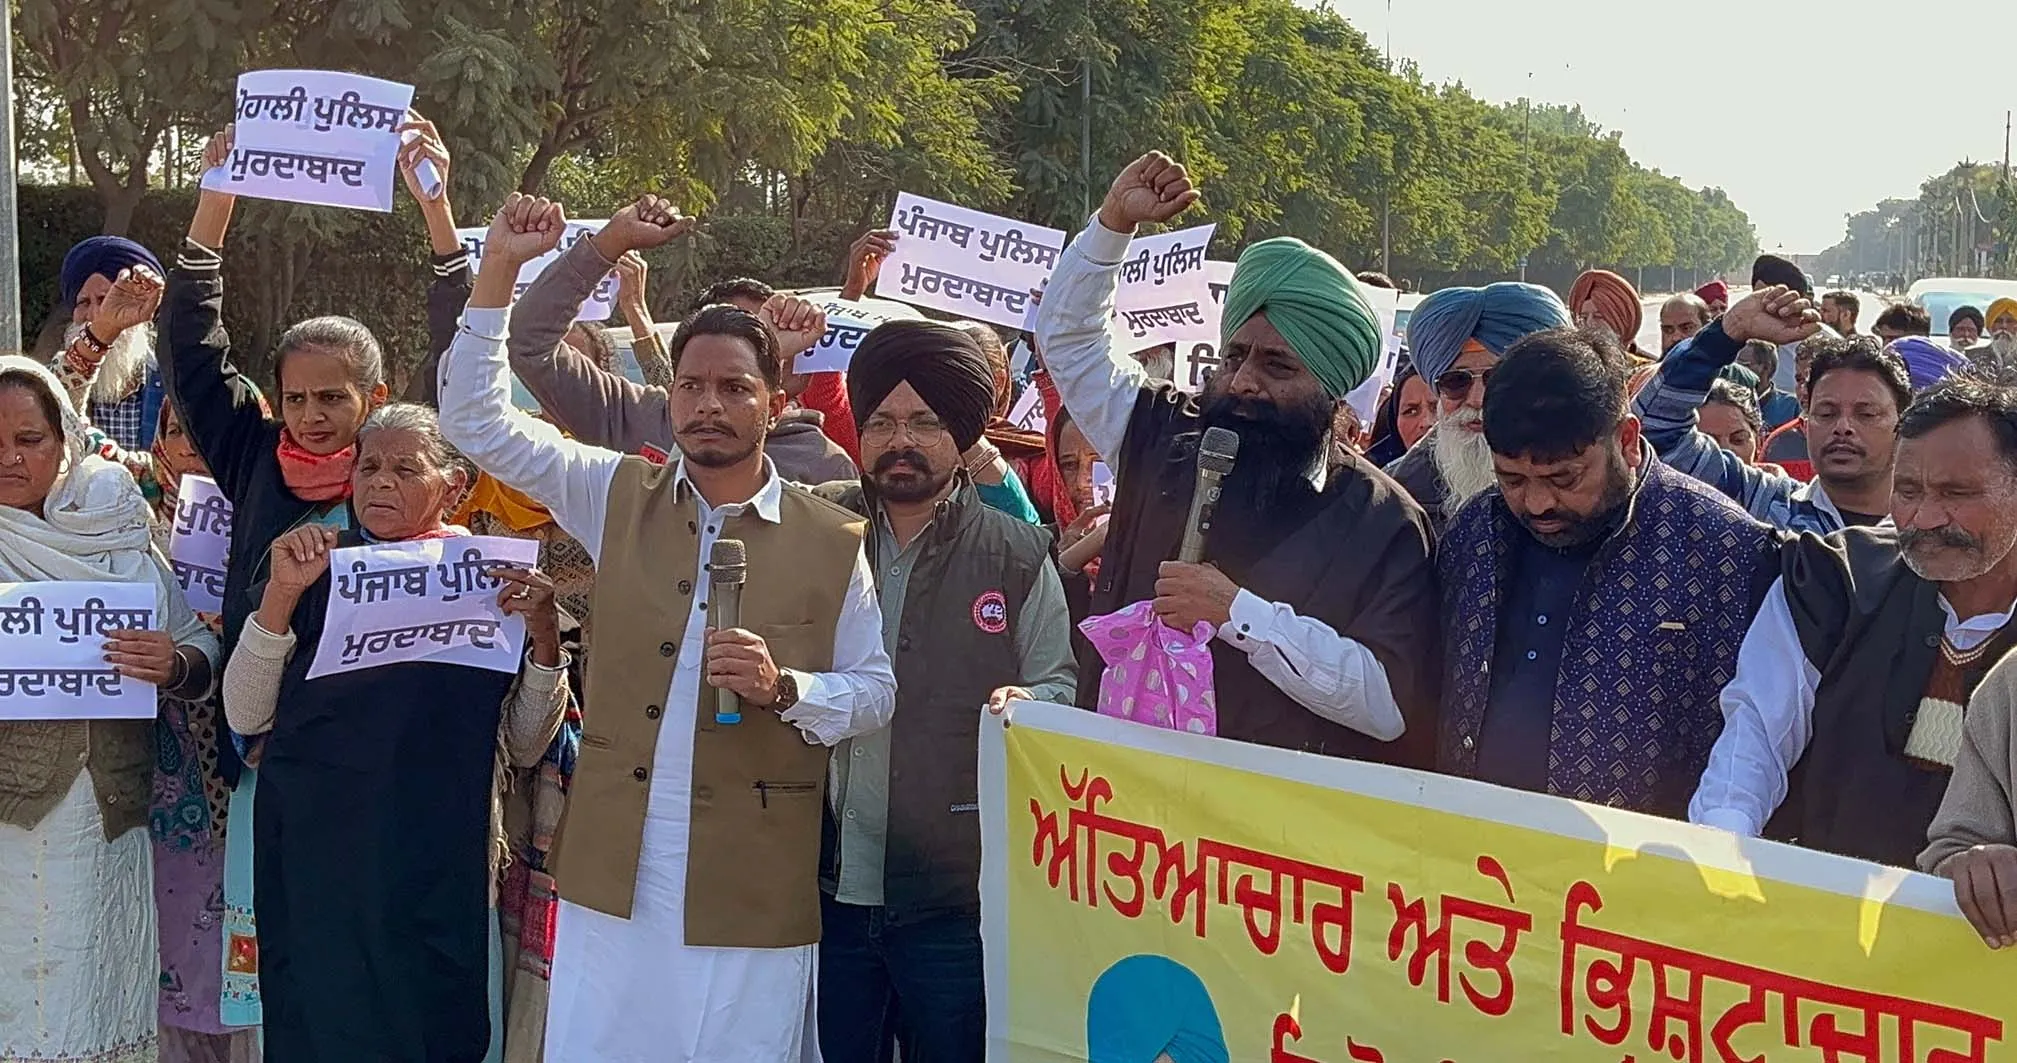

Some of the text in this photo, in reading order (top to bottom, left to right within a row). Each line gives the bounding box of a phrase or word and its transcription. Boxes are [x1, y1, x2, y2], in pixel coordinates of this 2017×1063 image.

[314, 91, 403, 133] ਪੁਲਿਸ
[231, 149, 366, 187] ਮੁਰਦਾਬਾਦ
[898, 205, 1060, 271] ਪੰਜਾਬ ਪੁਲਿਸ
[1153, 243, 1205, 285] ਪੁਲਿਸ
[900, 263, 1029, 314] ਮੁਰਦਾਬਾਦ
[1122, 302, 1205, 338] ਮੁਰਦਾਬਾਦ
[175, 495, 233, 536] ਪੁਲਿ
[337, 548, 534, 605] ਪੰਜਾਬ ਪੁਲਿ
[340, 619, 501, 665] ਮੁਰਦਾਬਾਦ
[1386, 855, 1533, 1017] ਅਤੇ
